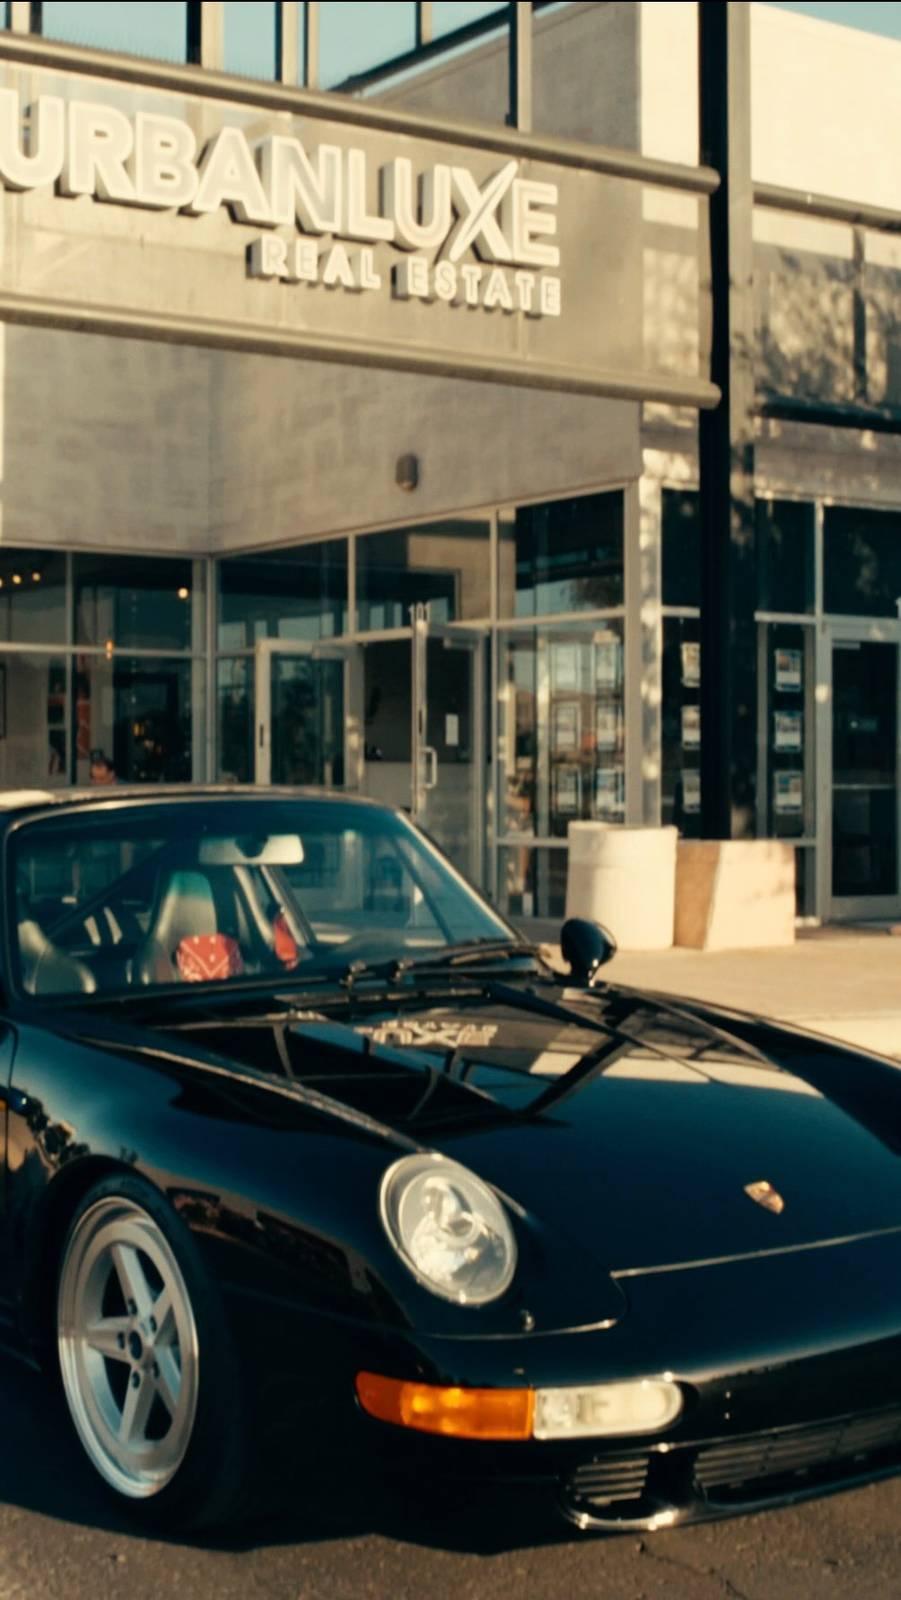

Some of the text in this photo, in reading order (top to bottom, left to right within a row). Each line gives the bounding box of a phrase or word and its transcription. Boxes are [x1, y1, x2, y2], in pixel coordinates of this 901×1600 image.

[0, 88, 560, 267] URBANLUXE
[257, 234, 561, 316] REAL ESTATE
